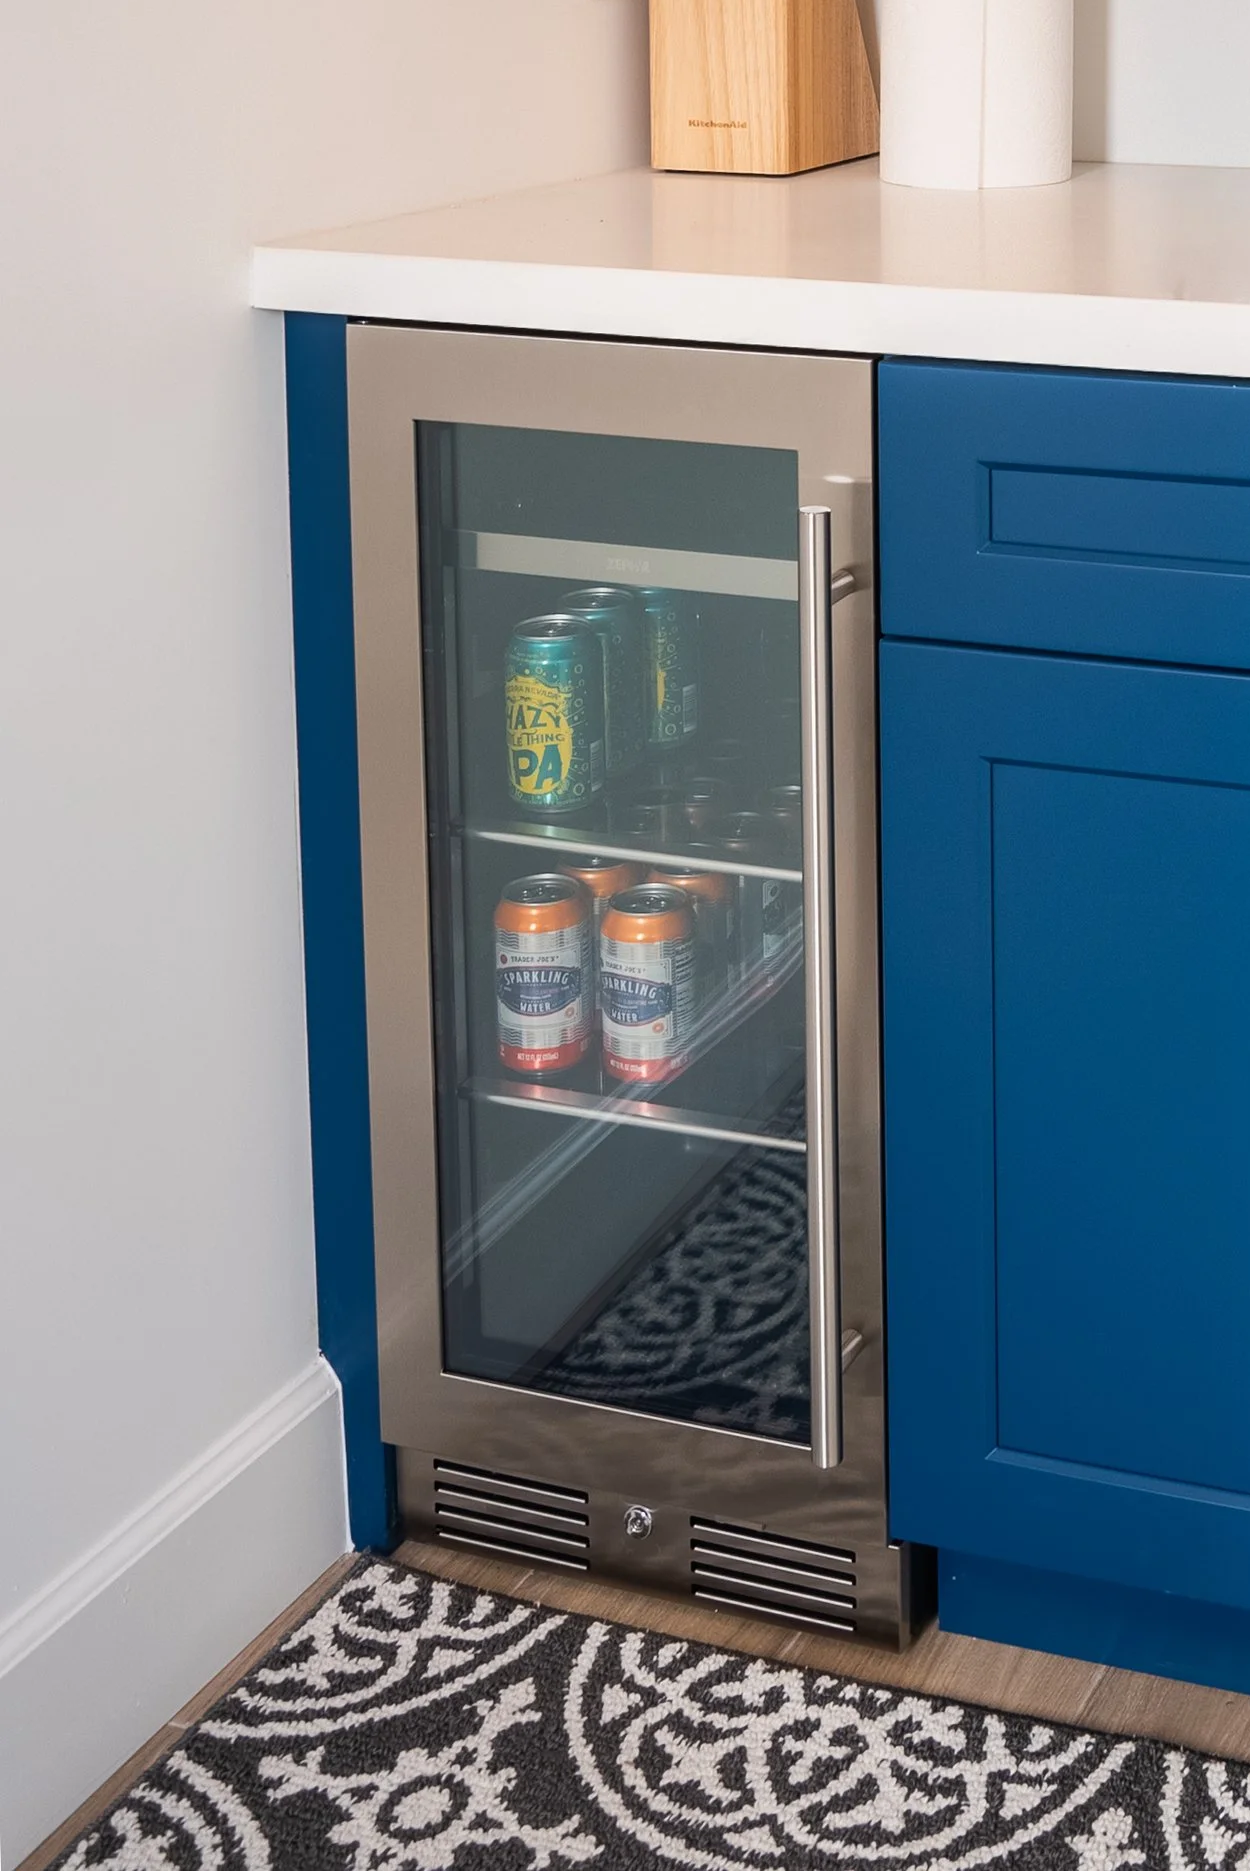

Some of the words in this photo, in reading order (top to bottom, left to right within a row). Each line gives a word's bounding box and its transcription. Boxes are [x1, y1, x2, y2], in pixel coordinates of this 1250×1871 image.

[688, 119, 748, 129] KitchenAid
[521, 732, 565, 746] THING
[503, 971, 570, 986] SPARKLING
[520, 1002, 551, 1013] WATER
[611, 1008, 638, 1023] WATER
